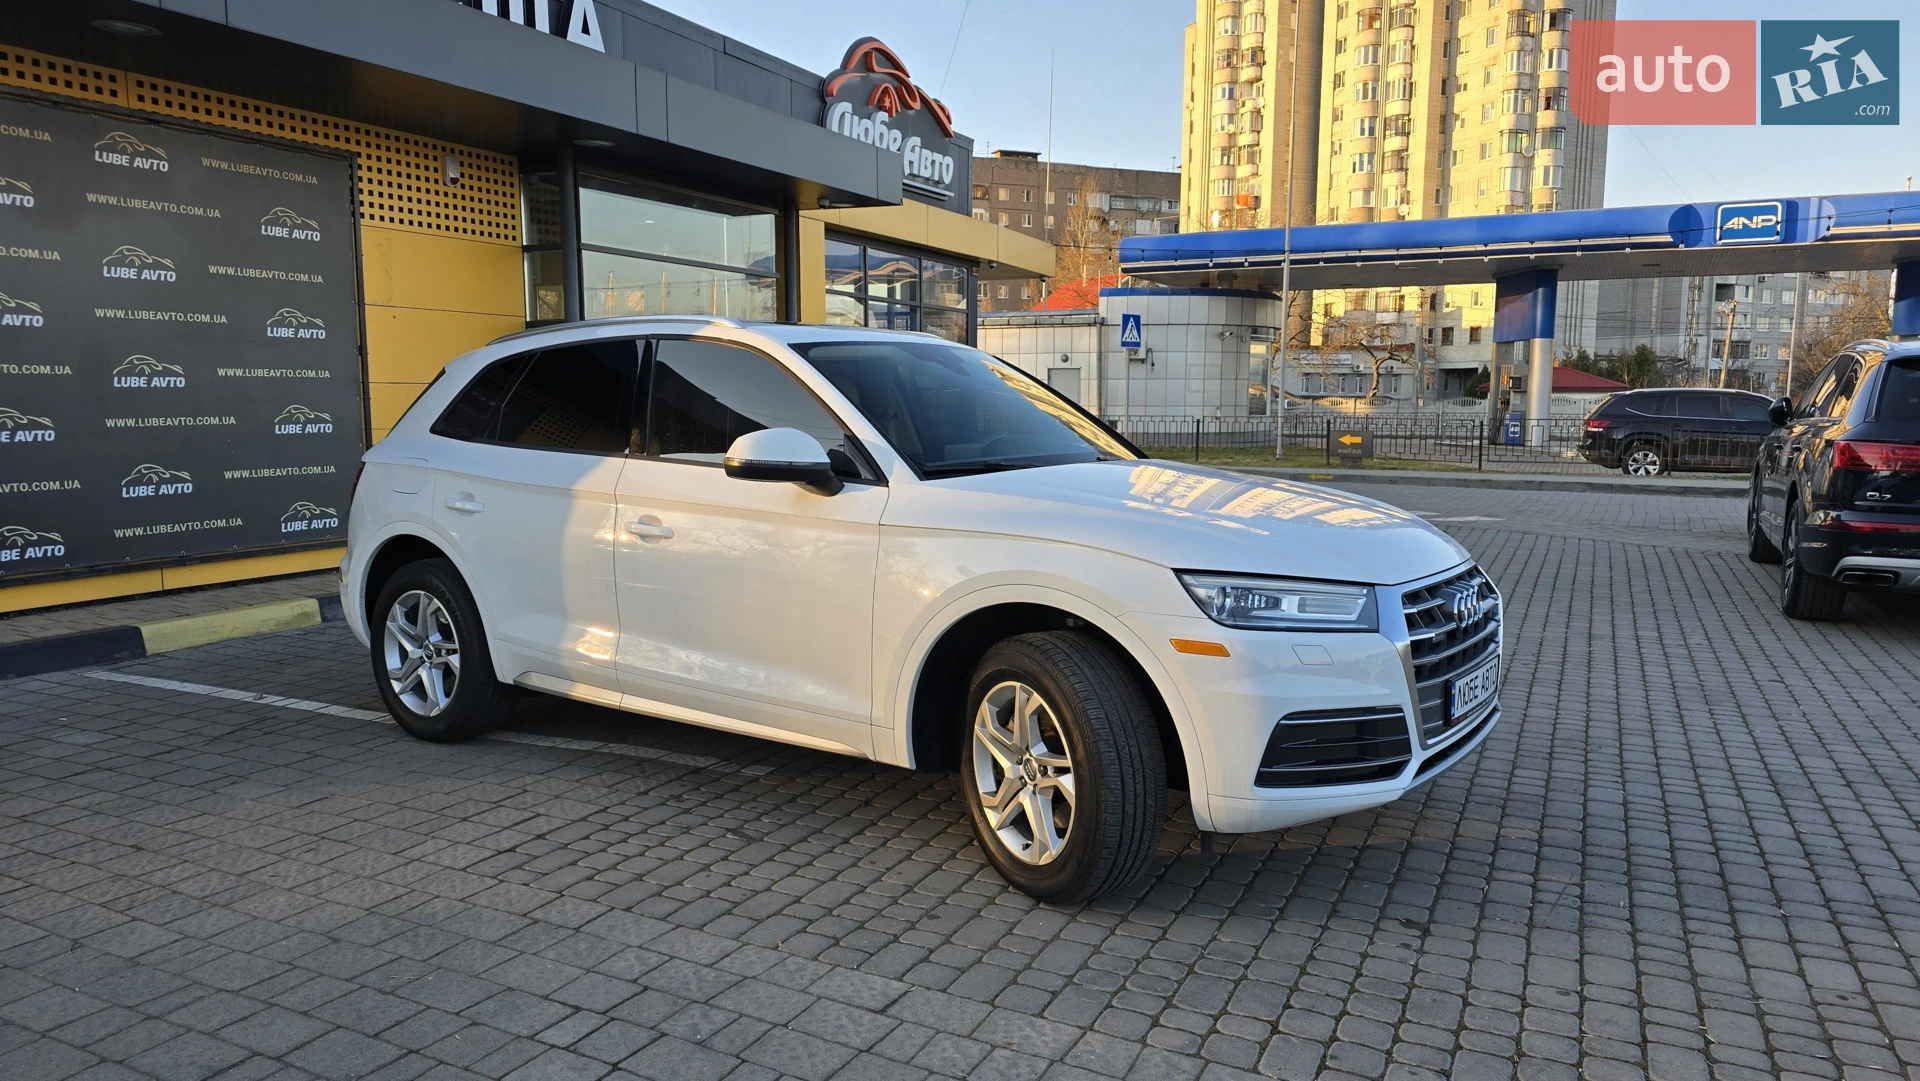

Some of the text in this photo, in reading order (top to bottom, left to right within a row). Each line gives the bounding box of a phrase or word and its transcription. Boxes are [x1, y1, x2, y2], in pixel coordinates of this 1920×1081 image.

[0, 125, 51, 141] COM.UA
[827, 101, 954, 184] Любе Авто
[95, 150, 168, 171] LUBE AVTO
[201, 158, 318, 184] WWW.LUBEAVTO.COM.UA
[86, 193, 220, 218] WWW.LUBEAVTO.COM.UA
[1722, 215, 1777, 230] ANP
[262, 225, 320, 241] LUBE AVTO
[103, 266, 176, 281] LUBE AVTO
[209, 265, 323, 283] WWW.LUBEAVTO.COM.UA
[2, 314, 43, 326] AVTO
[95, 308, 227, 323] WWW.LUBEAVTO.COM.UA
[267, 327, 325, 339] LUBE AVTO
[0, 364, 72, 374] TO.COM.UA
[218, 368, 330, 377] WWW.LUBEAVTO.COM.UA
[114, 377, 185, 387] LUBE AVTO
[105, 417, 236, 427] WWW.LUBEAVTO.COM.UA
[276, 424, 332, 434] LUBE AVTO
[14, 430, 55, 442] AVTO
[224, 466, 335, 479] WWW.LUBEAVTO.COM.UA
[0, 480, 81, 492] VTO.COM.UA
[122, 483, 192, 497] LUBE AVTO
[1866, 491, 1892, 501] Q7
[114, 518, 242, 537] WWW.LUBEAVTO.COM.UA
[281, 518, 338, 532] LUBE AVTO
[25, 545, 64, 558] AVTO
[1456, 674, 1479, 711] ЛЮБЕ
